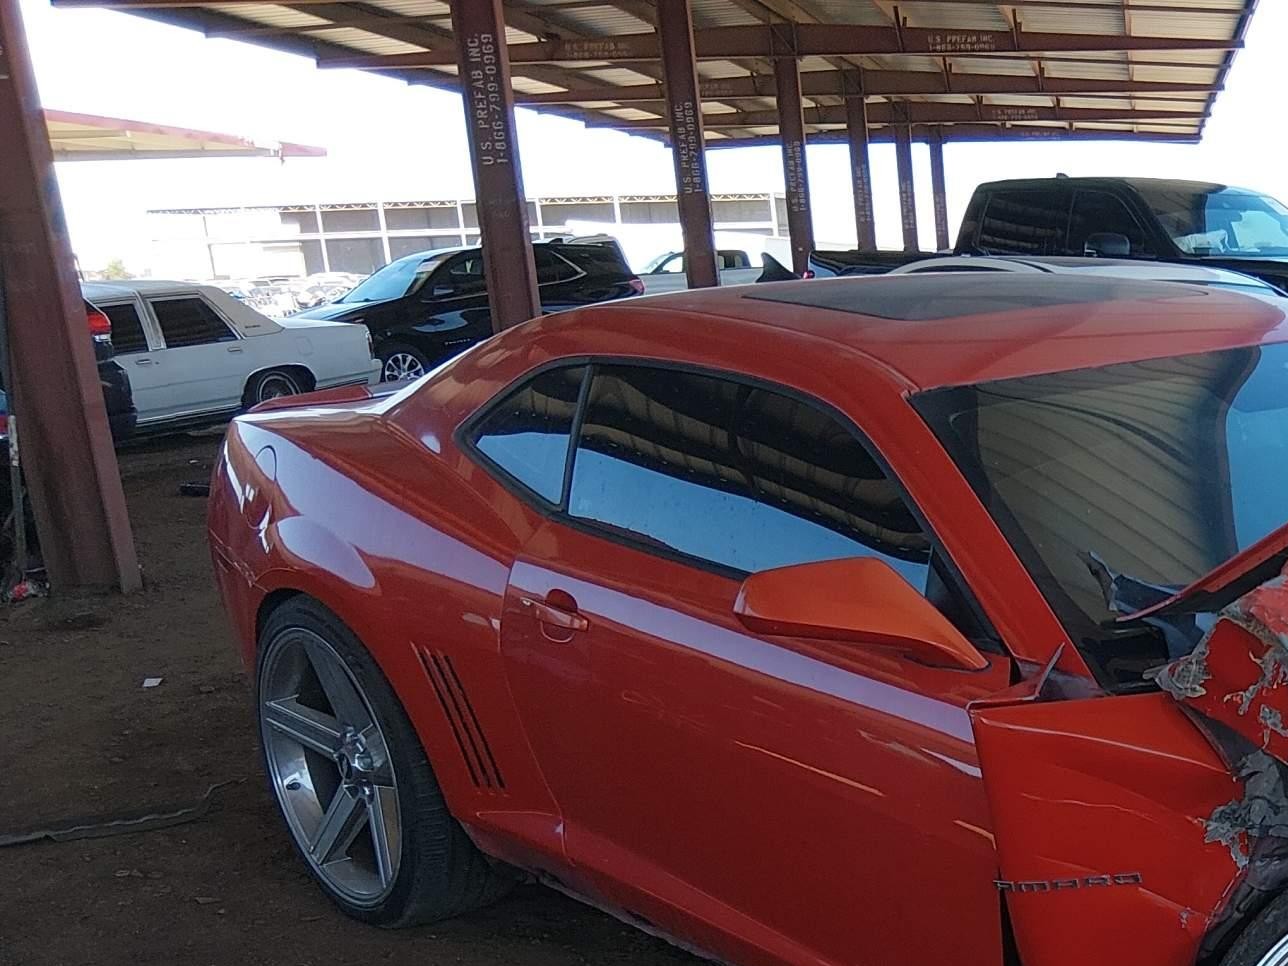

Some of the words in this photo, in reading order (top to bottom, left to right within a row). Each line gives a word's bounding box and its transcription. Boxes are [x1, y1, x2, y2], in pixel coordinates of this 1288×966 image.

[467, 33, 481, 63] INC.
[471, 69, 490, 129] PREFAB
[481, 33, 508, 165] 1-866-799-0969
[677, 126, 690, 168] PREFAB
